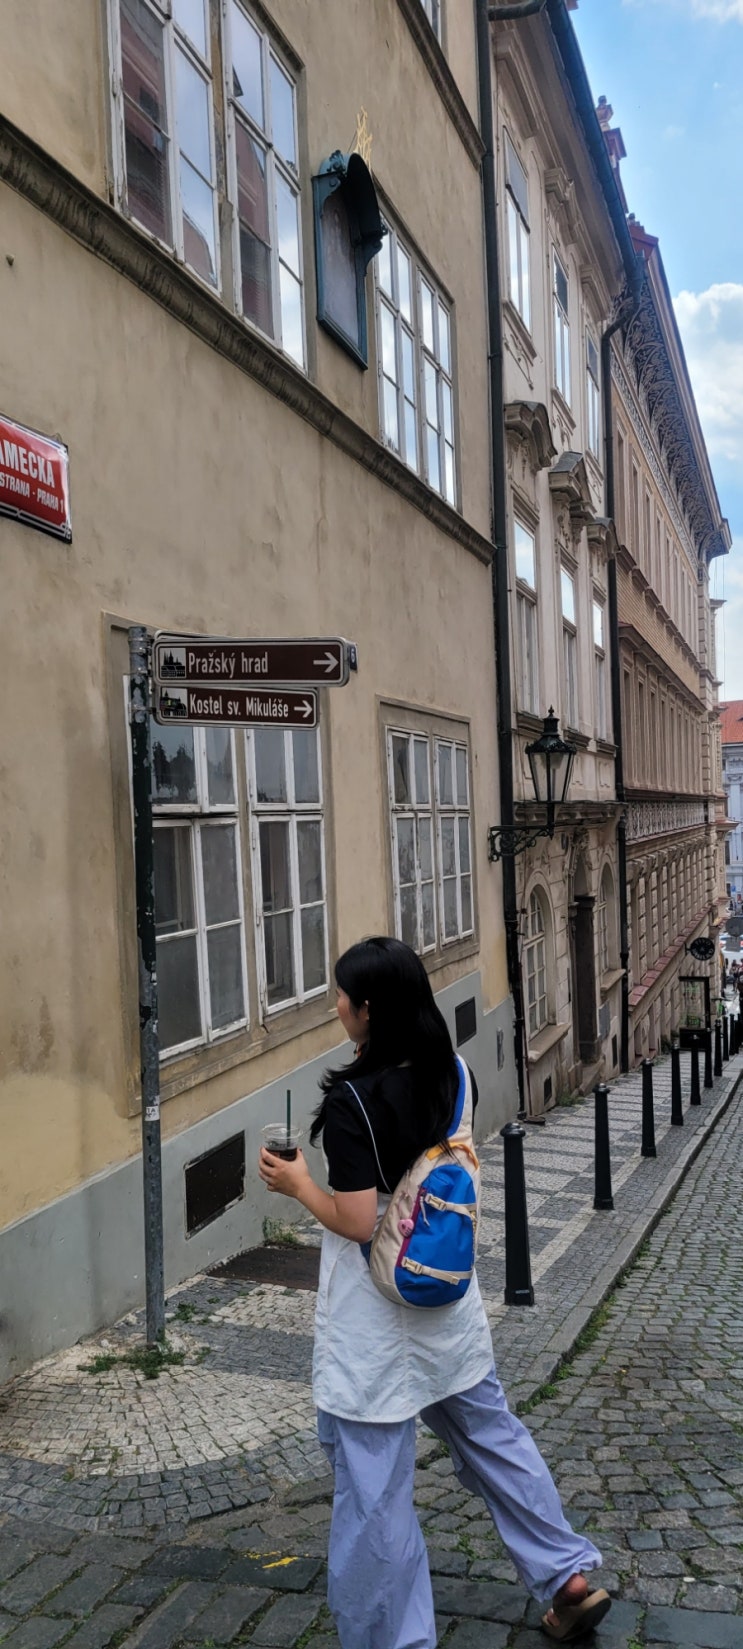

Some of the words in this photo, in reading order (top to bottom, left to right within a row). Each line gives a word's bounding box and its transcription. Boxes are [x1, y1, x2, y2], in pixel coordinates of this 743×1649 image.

[0, 471, 30, 498] STRANA
[37, 488, 58, 511] PRAHA
[60, 499, 64, 513] 1
[188, 649, 236, 678] Pražský
[241, 652, 268, 673] hrad
[189, 693, 223, 715] Kostel
[227, 702, 241, 716] sv.
[246, 697, 289, 718] Mikuláše
